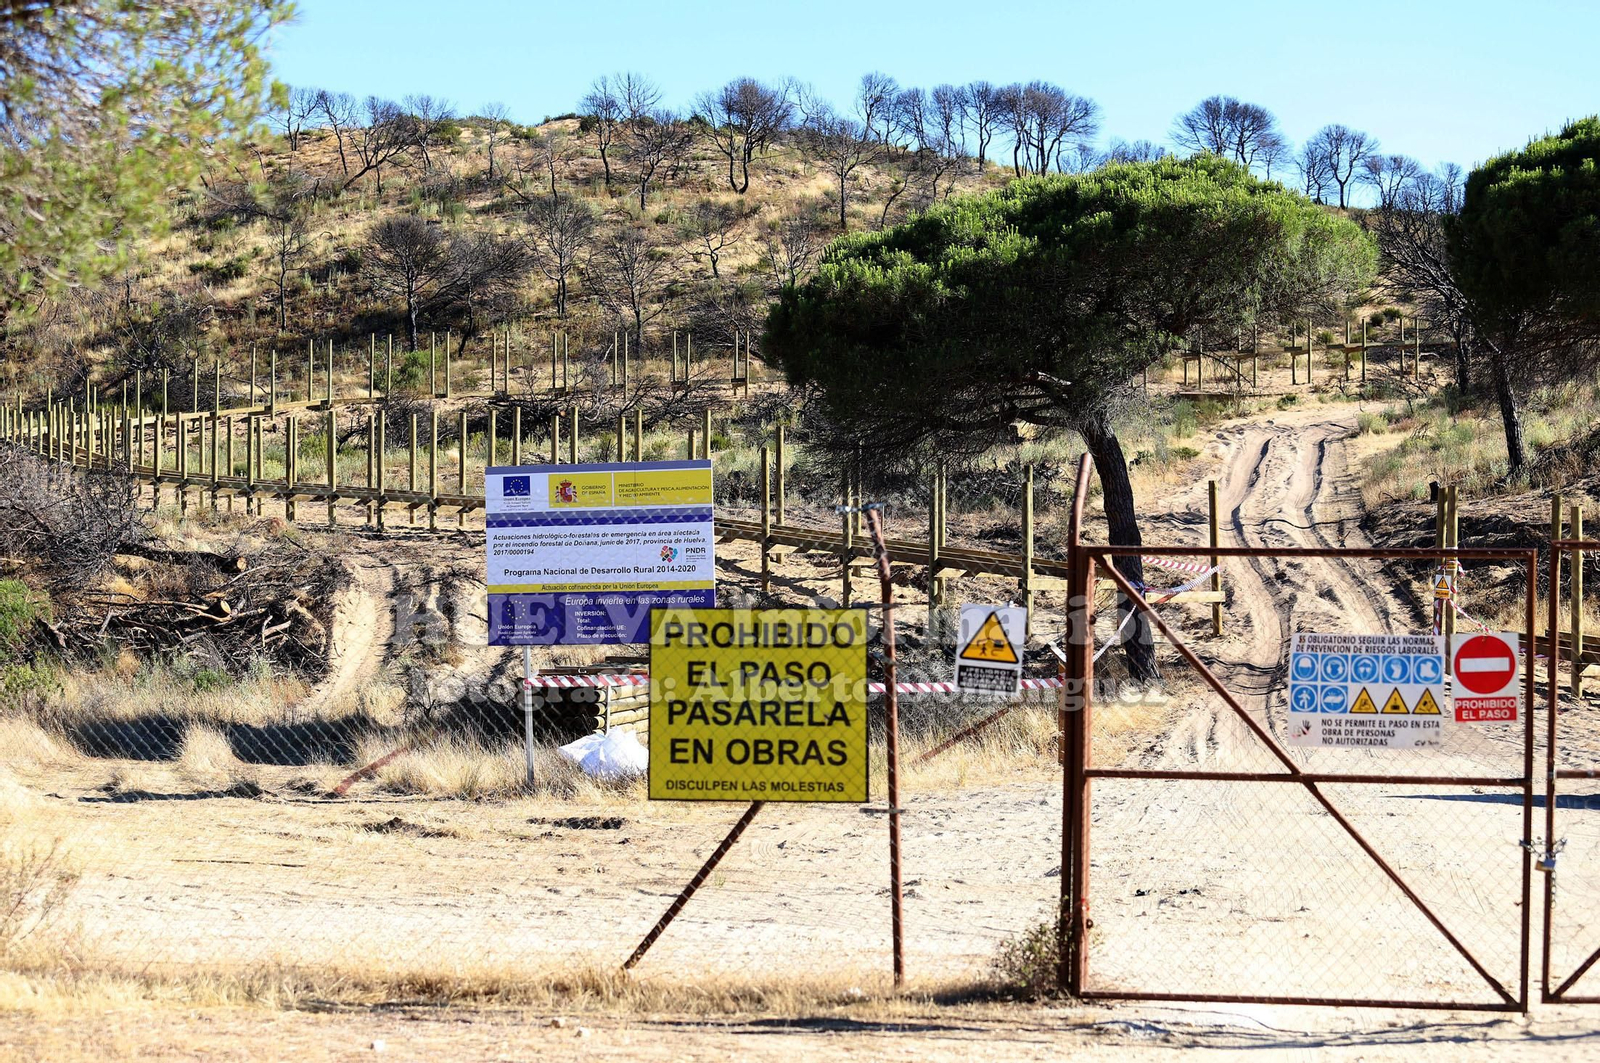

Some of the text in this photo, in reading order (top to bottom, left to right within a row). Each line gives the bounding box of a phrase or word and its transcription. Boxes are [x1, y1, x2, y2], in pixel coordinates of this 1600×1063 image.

[504, 569, 541, 577] Programa
[591, 566, 631, 575] Desarrollo
[656, 565, 696, 573] 2014-2020
[565, 597, 593, 606] Europa
[595, 596, 623, 605] invierte
[638, 596, 650, 604] las
[677, 595, 705, 604] rurales
[664, 622, 855, 649] PROHIBIDO
[1308, 635, 1356, 645] OBLIGATORIO
[1358, 636, 1386, 645] SEGUIR
[1388, 636, 1400, 645] LAS
[1402, 636, 1435, 645] NORMAS
[1296, 644, 1439, 655] DE PREVENCION DE RIESGOS LABORALES
[687, 661, 832, 688] EL PASO
[1455, 699, 1516, 709] PROHIBIDO
[668, 700, 851, 726] PASARELA
[1462, 710, 1510, 719] EL PASO
[1322, 719, 1440, 728] NO SE PERMITE EL PASO EN ESTA
[1335, 738, 1388, 746] AUTORIZADAS
[670, 738, 848, 766] EN OBRAS
[666, 779, 844, 792] DISCULPEN LAS MOLESTIAS
